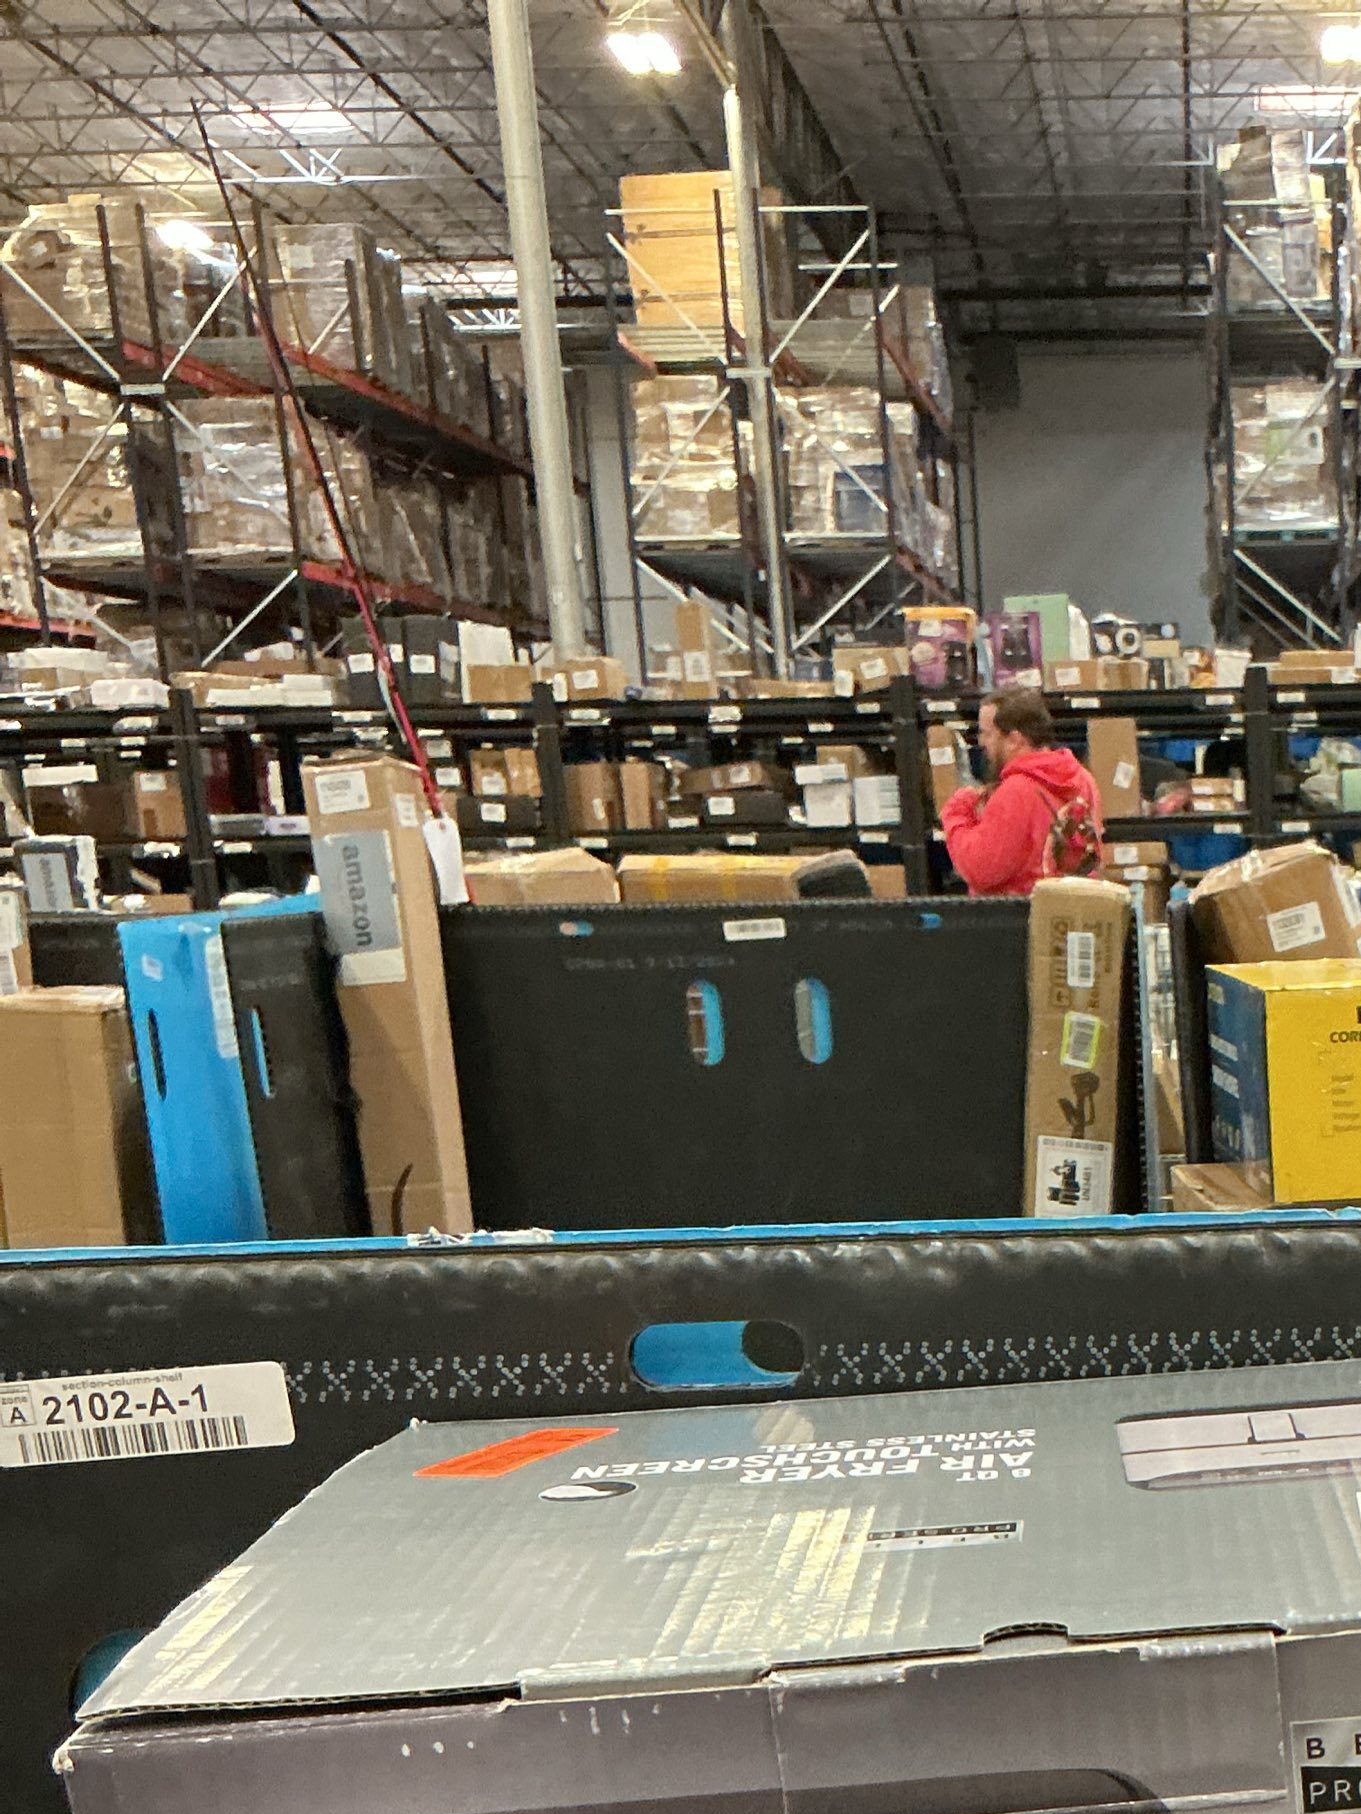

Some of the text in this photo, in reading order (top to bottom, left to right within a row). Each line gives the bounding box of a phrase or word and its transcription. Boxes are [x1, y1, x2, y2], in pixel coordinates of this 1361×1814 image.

[341, 845, 375, 947] amazon
[10, 1406, 27, 1424] A
[42, 1384, 209, 1426] 2102-A-1
[760, 1429, 1036, 1453] STAINLESS STEEL
[570, 1438, 1036, 1480] WITH TOUCHSCREEN
[739, 1451, 1034, 1484] AIR FRYER
[955, 1470, 999, 1482] QT
